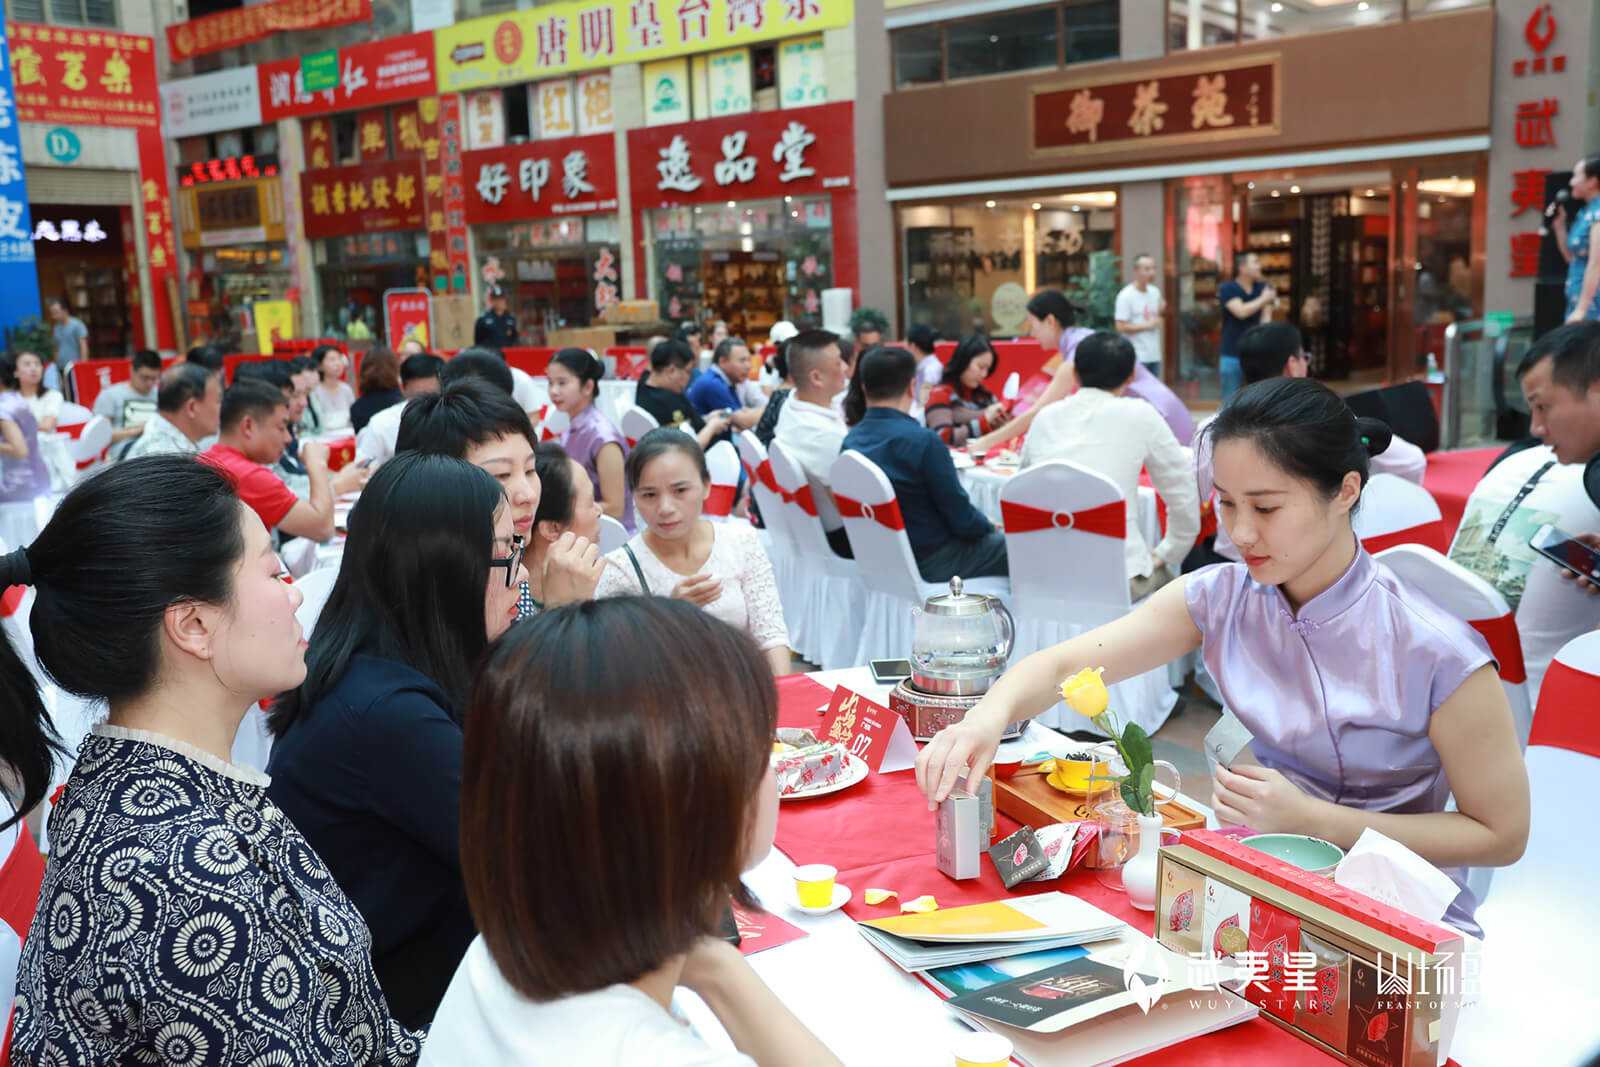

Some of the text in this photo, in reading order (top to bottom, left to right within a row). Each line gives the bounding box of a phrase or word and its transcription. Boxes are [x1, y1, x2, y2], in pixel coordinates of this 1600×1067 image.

[1065, 73, 1234, 143] 御茶苑
[475, 150, 596, 205] 好印象
[656, 121, 816, 192] 逸品堂
[594, 247, 621, 320] 大红
